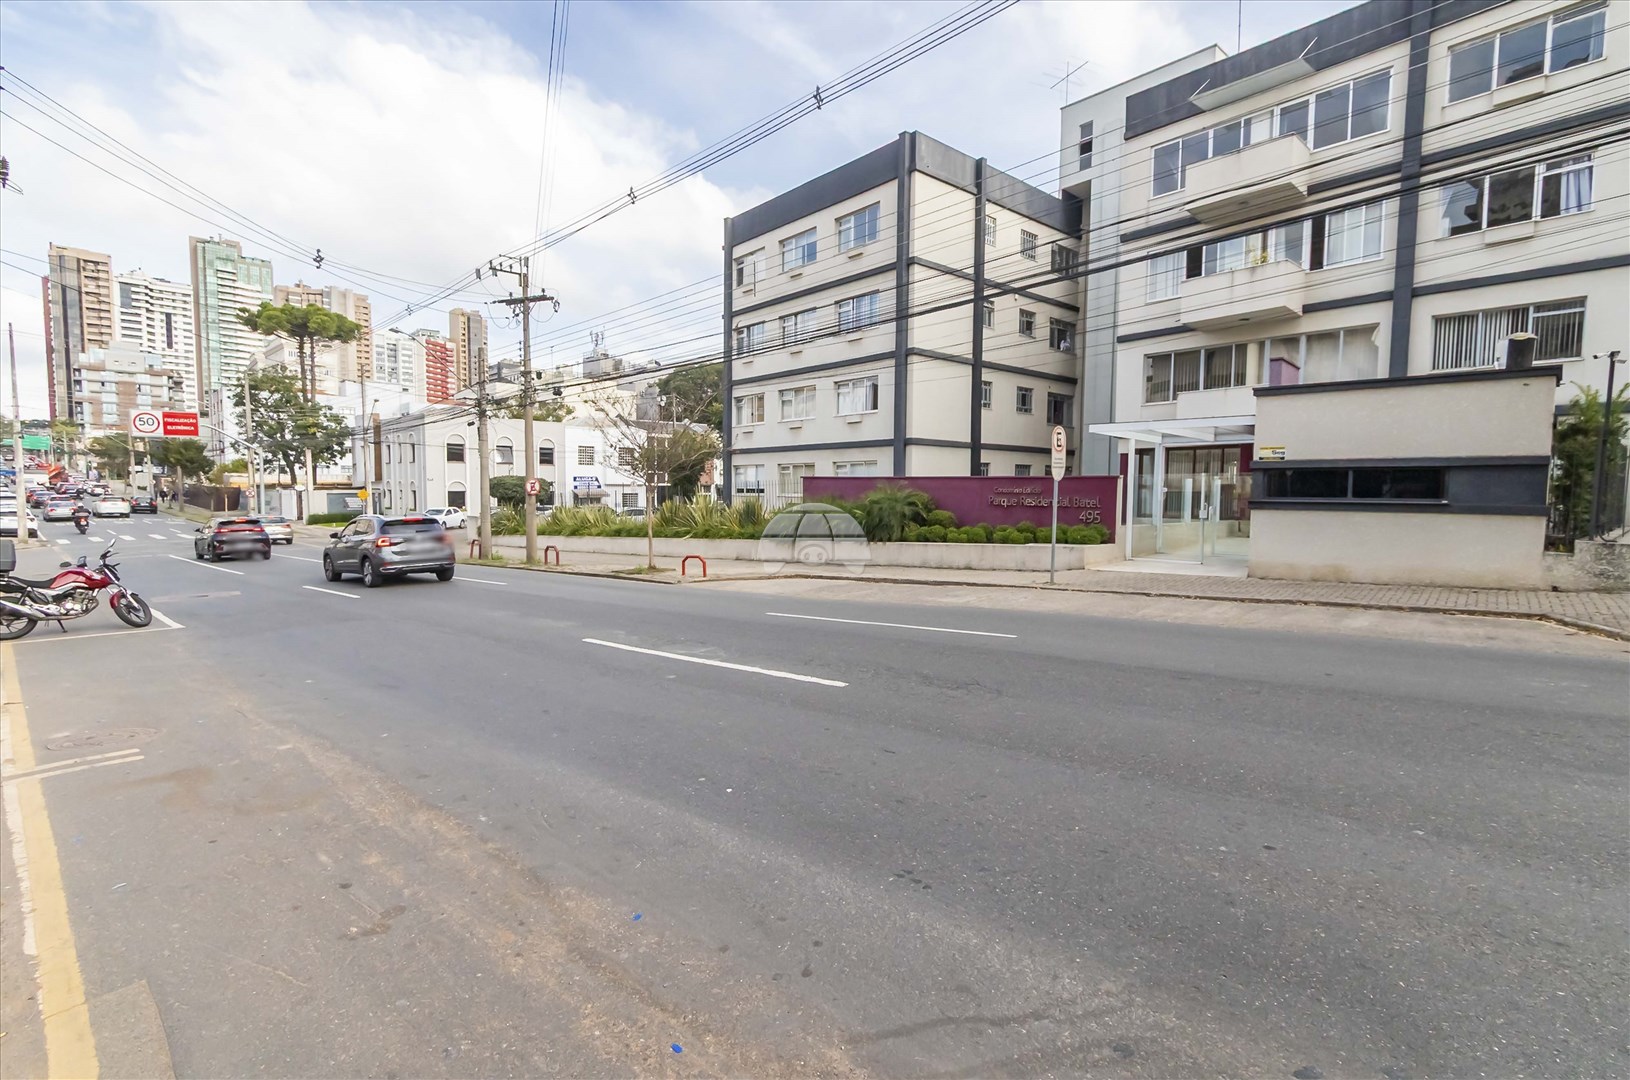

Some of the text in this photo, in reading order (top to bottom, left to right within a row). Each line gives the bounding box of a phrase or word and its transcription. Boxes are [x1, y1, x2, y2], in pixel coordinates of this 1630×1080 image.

[138, 417, 155, 426] 50
[1057, 432, 1062, 447] E
[988, 495, 1018, 508] Parque
[1073, 496, 1101, 508] Batel
[1079, 510, 1101, 523] 495
